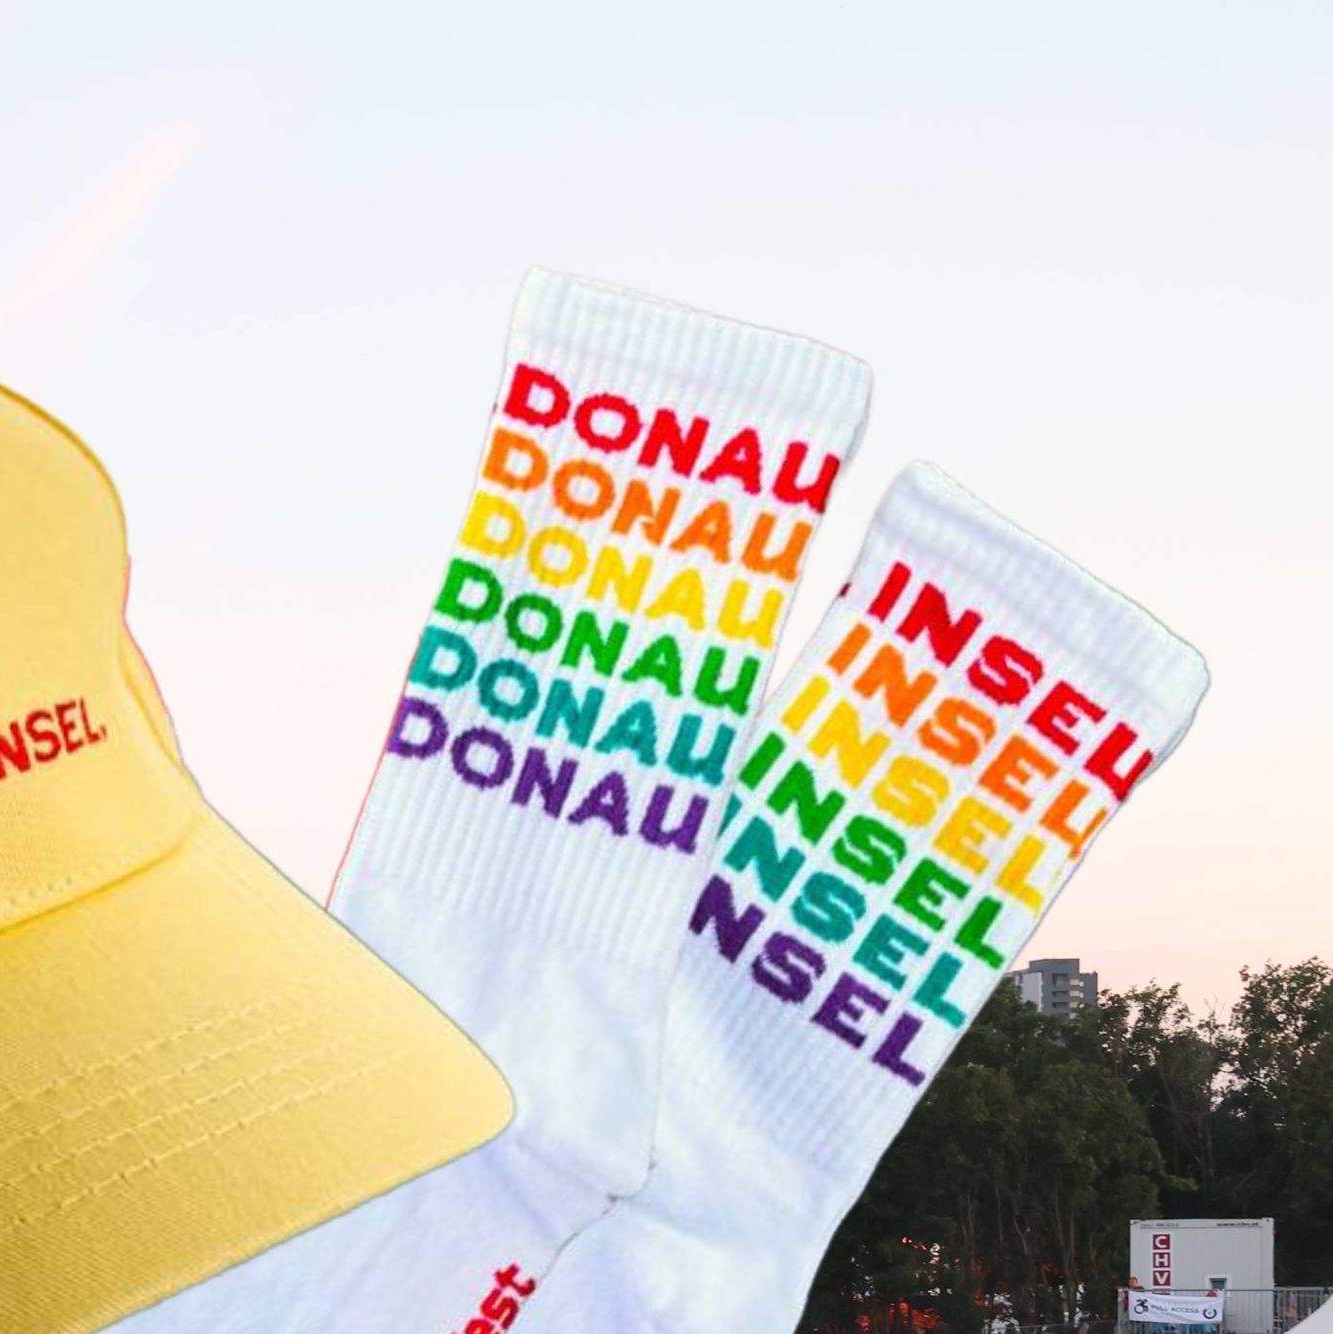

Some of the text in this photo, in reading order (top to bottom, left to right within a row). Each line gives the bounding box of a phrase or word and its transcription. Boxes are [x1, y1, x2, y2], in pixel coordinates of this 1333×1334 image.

[482, 426, 813, 583] DONAU
[503, 364, 841, 514] DONAU
[433, 556, 760, 716] DONAU
[459, 490, 785, 650] DONAU
[408, 624, 735, 787] DONAU
[826, 623, 1108, 860] INSEL
[867, 561, 1154, 803] INSEL
[387, 696, 709, 855] DONAU
[738, 732, 1005, 970] INSEL
[780, 675, 1046, 915] INSEL
[688, 876, 926, 1087] NSEL
[1153, 1234, 1171, 1287] CHV
